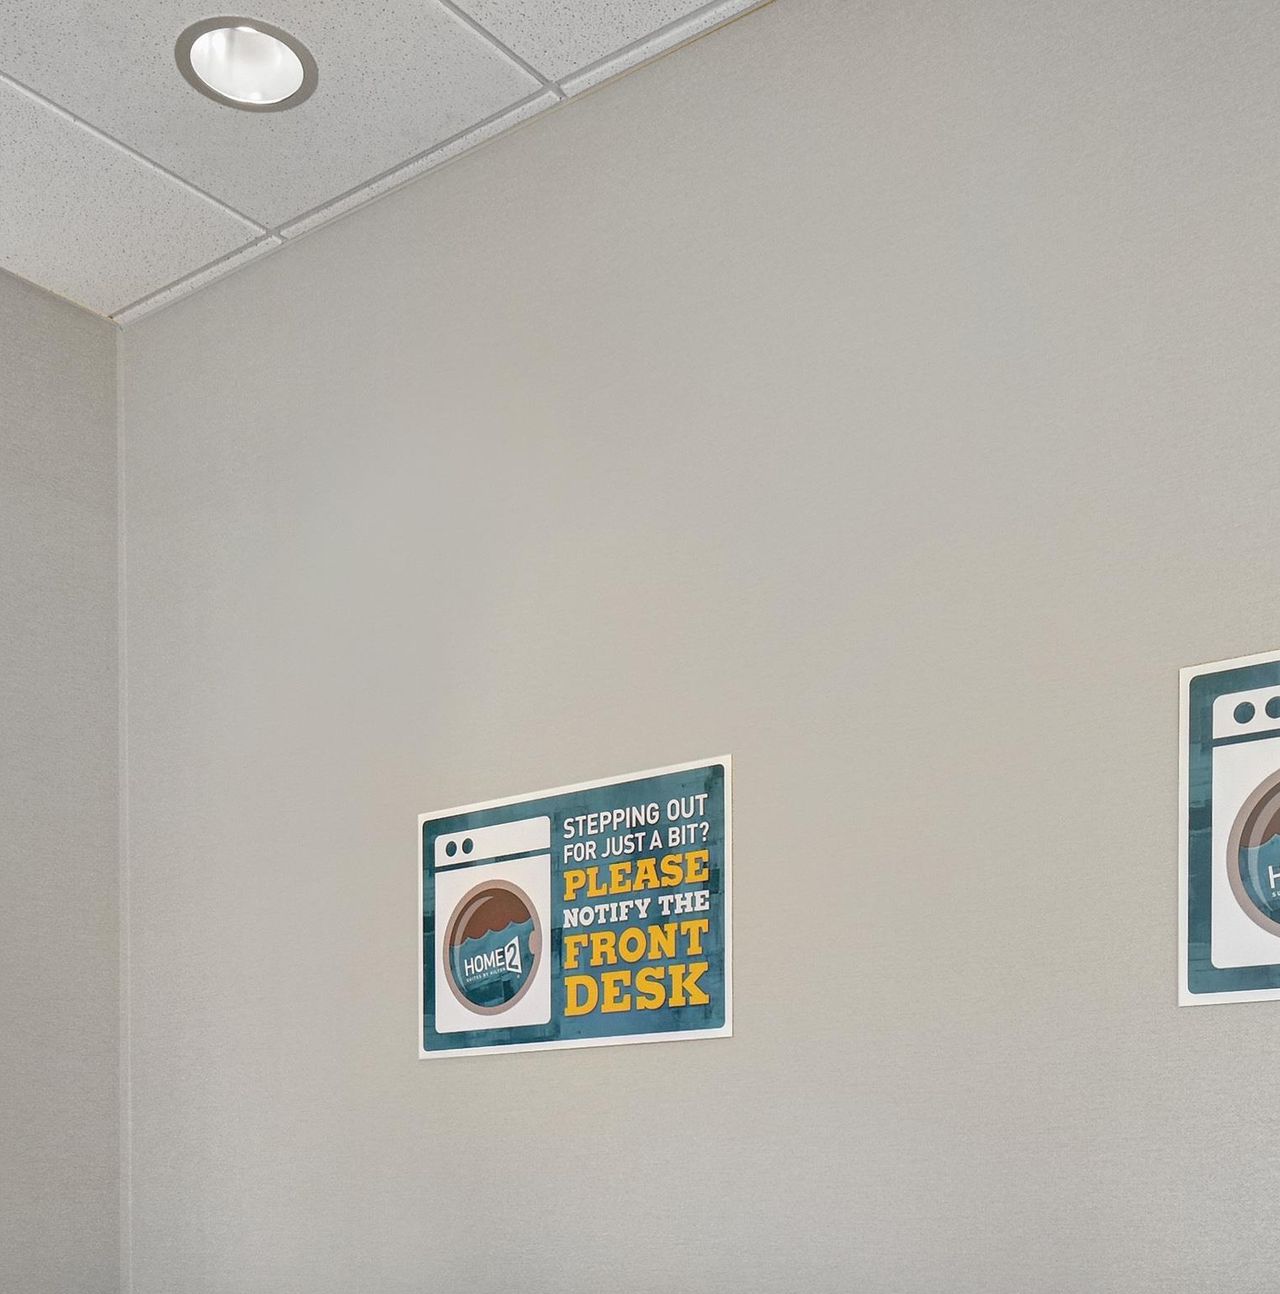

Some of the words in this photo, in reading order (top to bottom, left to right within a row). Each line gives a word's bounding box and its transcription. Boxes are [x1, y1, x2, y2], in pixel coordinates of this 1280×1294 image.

[563, 803, 660, 839] STEPPING
[667, 793, 708, 821] OUT
[564, 841, 597, 864] FOR
[601, 831, 647, 858] JUST
[649, 829, 663, 850] A
[668, 821, 710, 847] BIT?
[563, 849, 710, 901] PLEASE
[563, 898, 651, 929] NOTIFY
[658, 890, 710, 917] THE
[564, 919, 709, 970] FRONT
[564, 961, 710, 1017] DESK
